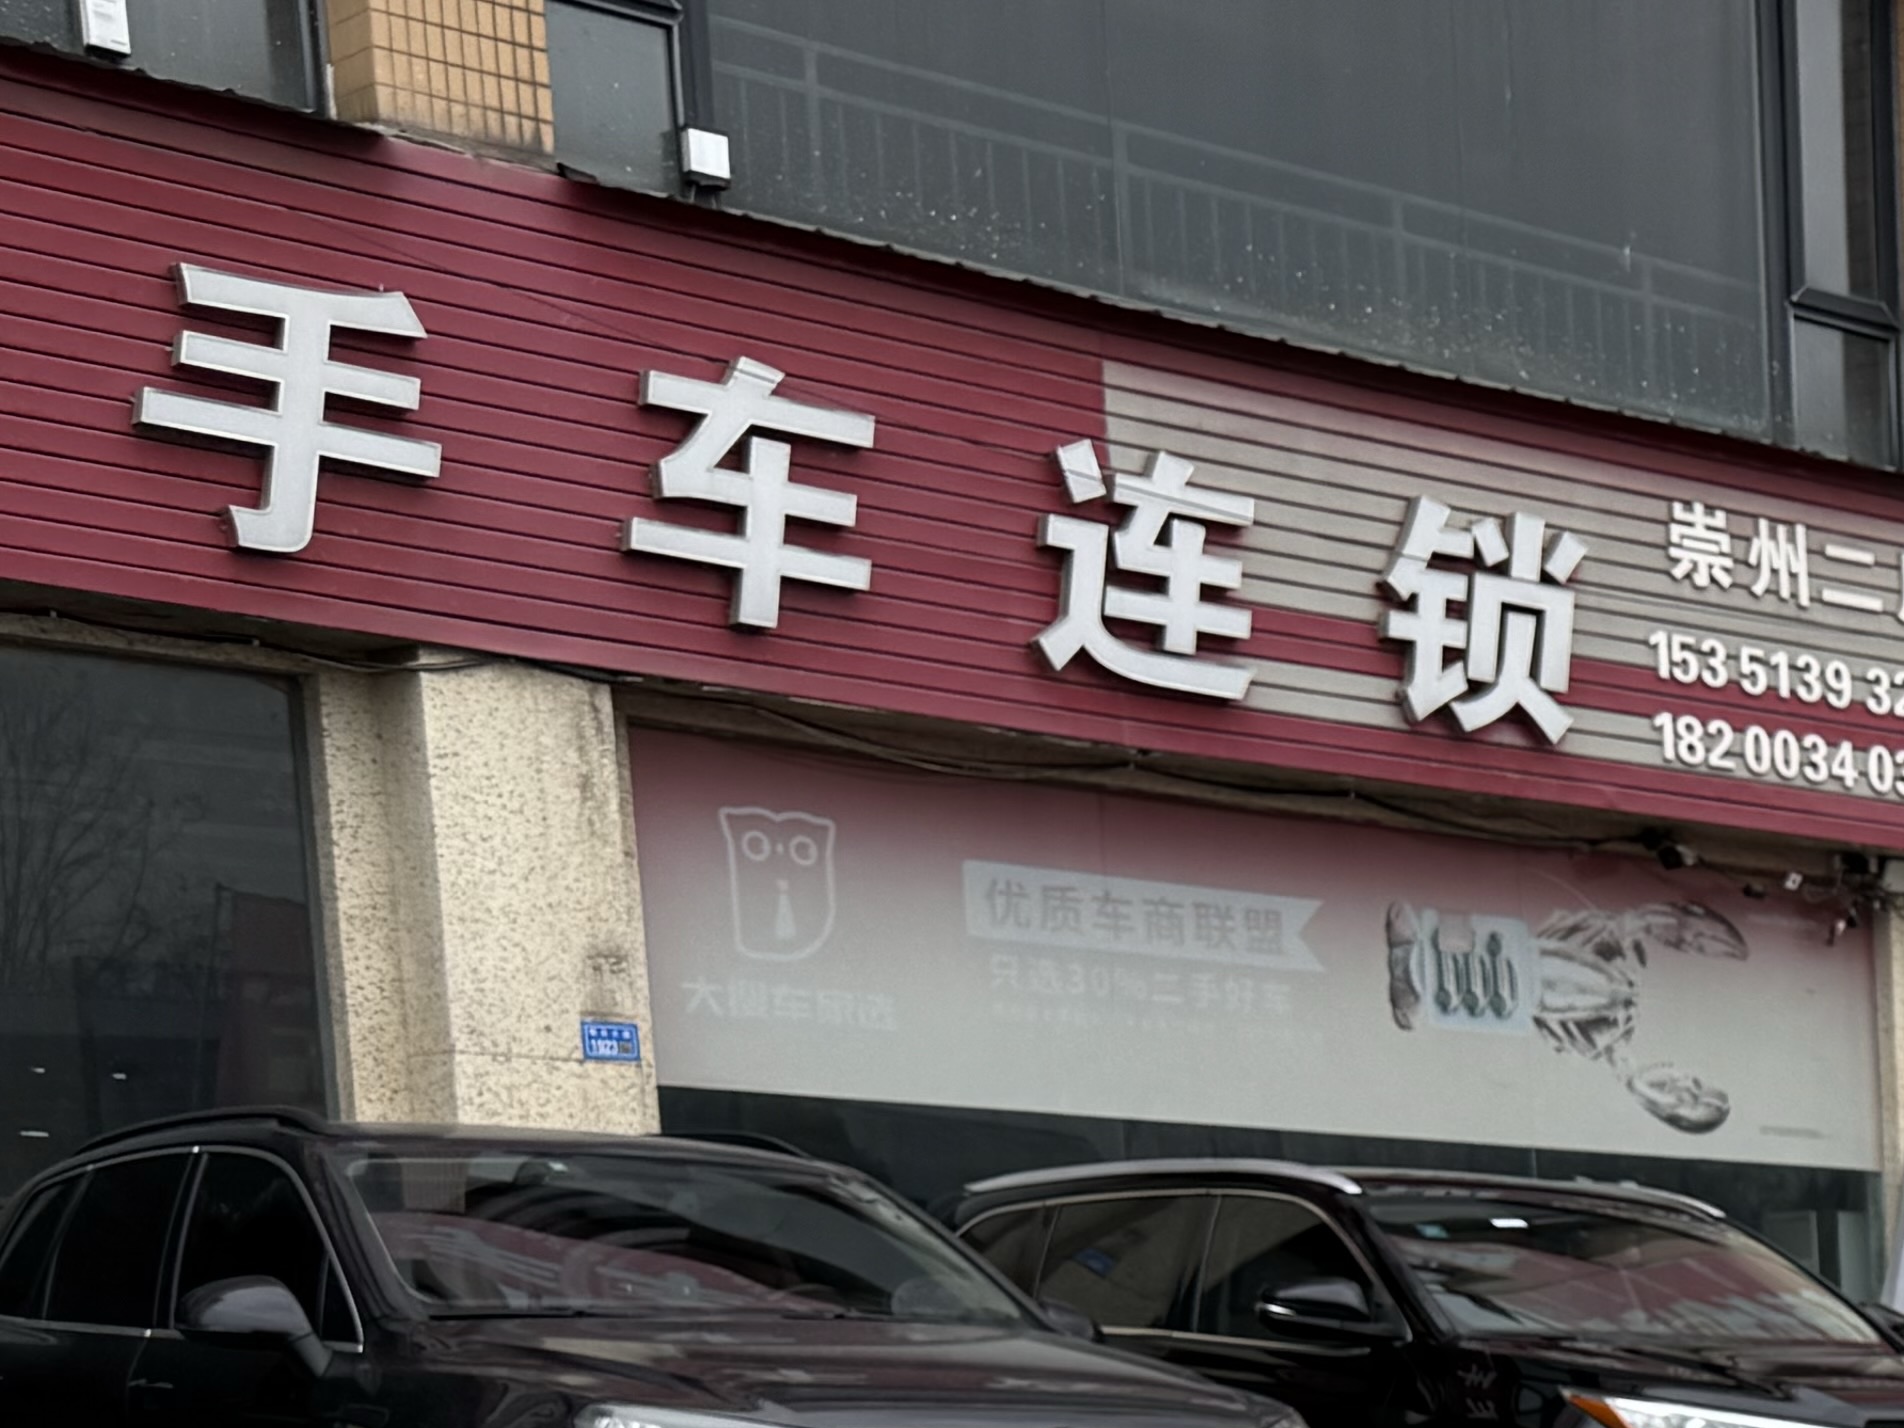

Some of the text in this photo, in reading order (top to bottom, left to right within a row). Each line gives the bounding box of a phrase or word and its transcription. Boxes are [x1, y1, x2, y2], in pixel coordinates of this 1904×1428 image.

[132, 262, 1589, 745] 手车连锁
[1648, 630, 1729, 688] 153
[1739, 645, 1852, 709] 5139
[1652, 712, 1736, 772] 182
[1744, 725, 1859, 788] 0034
[984, 878, 1287, 955] 优质车商联盟
